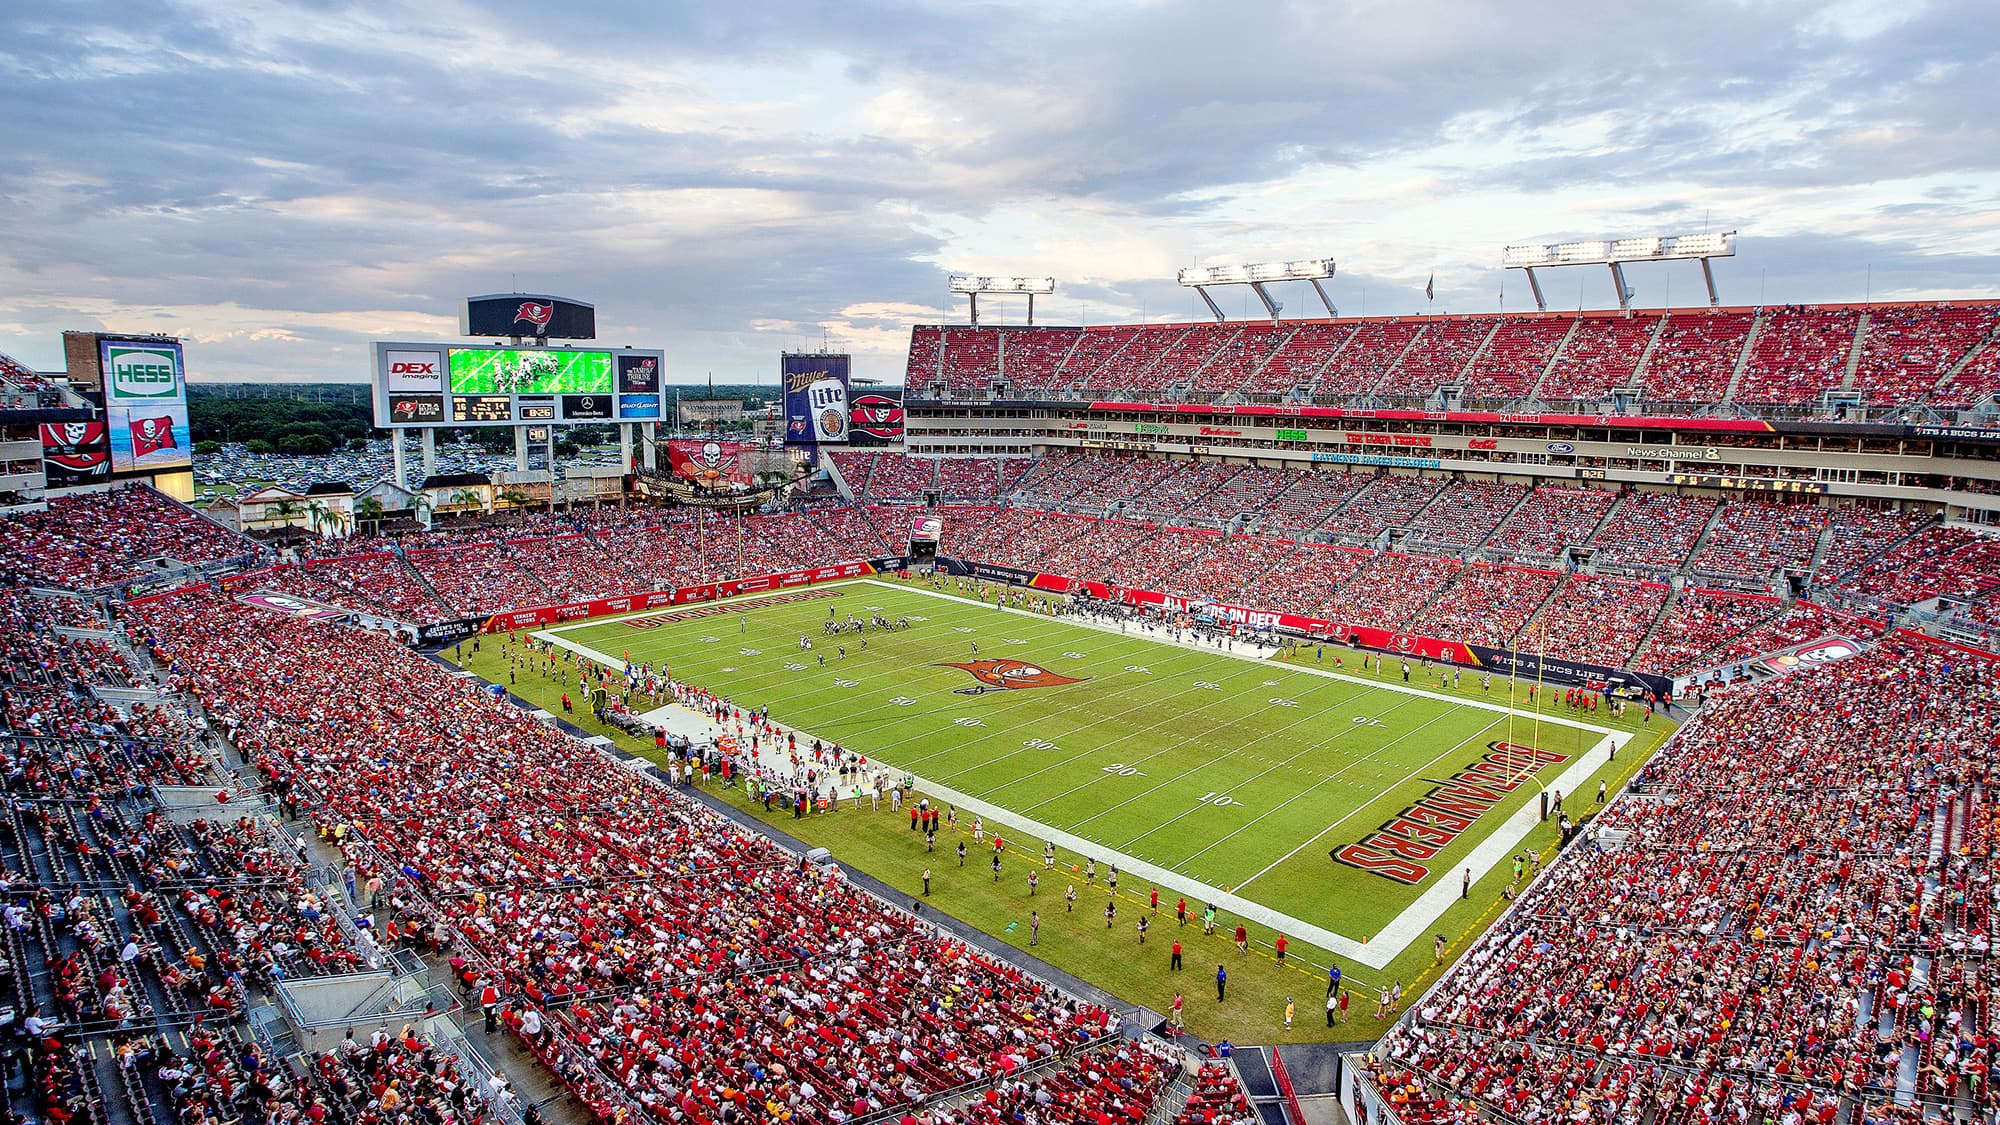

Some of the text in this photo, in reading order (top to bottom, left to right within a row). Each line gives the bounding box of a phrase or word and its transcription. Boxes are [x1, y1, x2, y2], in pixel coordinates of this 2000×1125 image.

[117, 364, 171, 383] HESS
[392, 363, 434, 374] DEX
[785, 370, 829, 393] Miller
[811, 388, 843, 410] Lite
[1276, 430, 1307, 440] HESS
[1345, 433, 1432, 446] THE TAMPA TRIBUNE
[1951, 430, 1977, 438] BUCS
[791, 449, 811, 463] Lite
[1628, 447, 1720, 460] News Channel 8
[1312, 453, 1440, 469] RAYMOND JAMES STADIUM
[622, 589, 844, 629] BUCCANEERS
[1230, 608, 1246, 624] ON
[1249, 610, 1281, 628] DECK
[1502, 657, 1605, 681] IT'S A BUCS LIFE
[888, 696, 917, 706] 50
[952, 717, 980, 727] 40
[1352, 716, 1383, 726] 10
[1022, 738, 1054, 750] 30
[1102, 763, 1137, 777] 20
[1196, 792, 1232, 807] 10
[1328, 740, 1572, 886] BUCCANEERS
